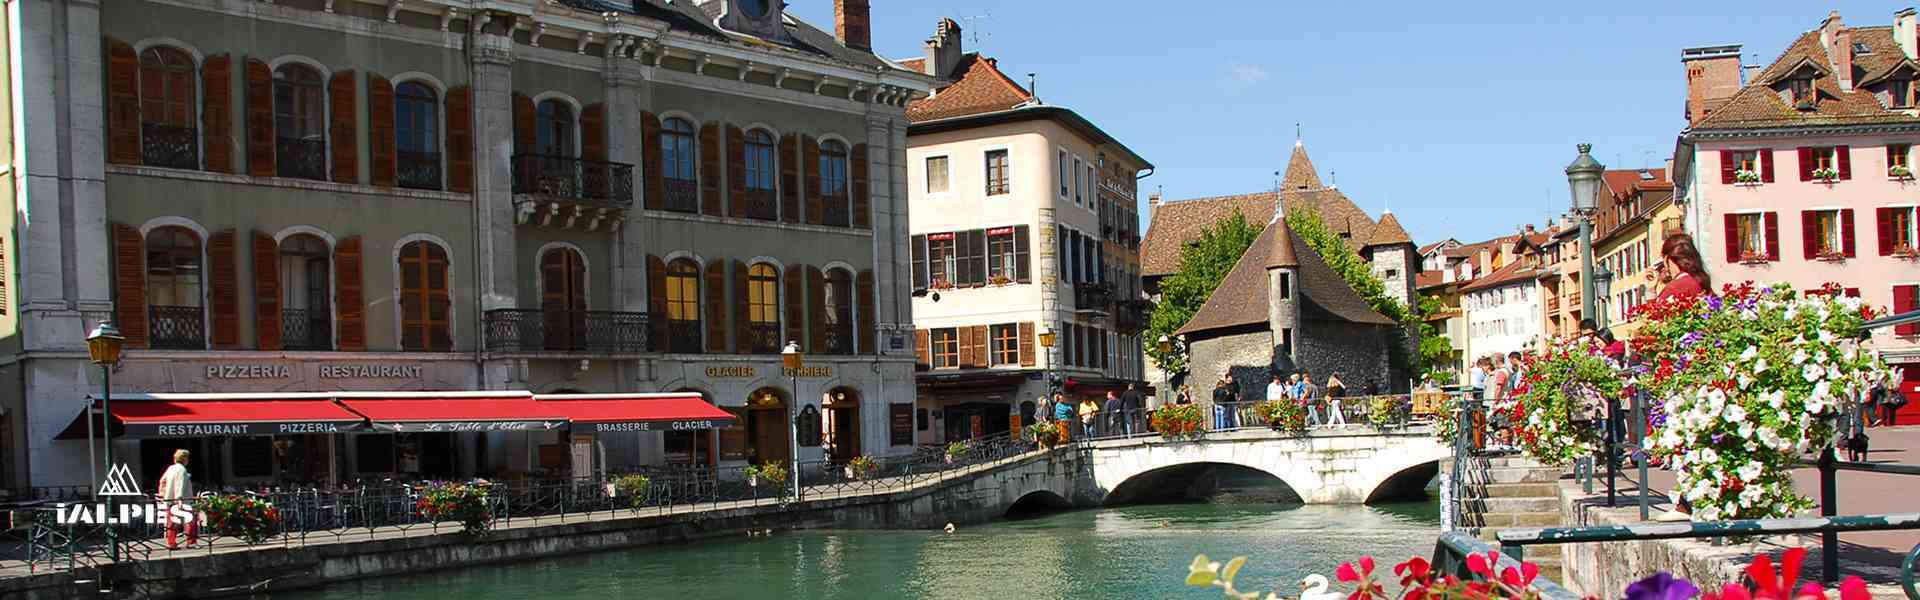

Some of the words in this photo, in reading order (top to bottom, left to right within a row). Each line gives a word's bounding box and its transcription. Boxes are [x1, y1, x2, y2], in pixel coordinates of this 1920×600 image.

[207, 365, 291, 378] PIZZERIA
[320, 364, 423, 378] RESTAURANT
[705, 367, 754, 377] GLACIER
[158, 424, 249, 436] RESTAURANT
[279, 422, 338, 433] PIZZERIA
[423, 423, 442, 433] La
[596, 422, 649, 432] BRASSERIE
[672, 420, 713, 430] GLACIER
